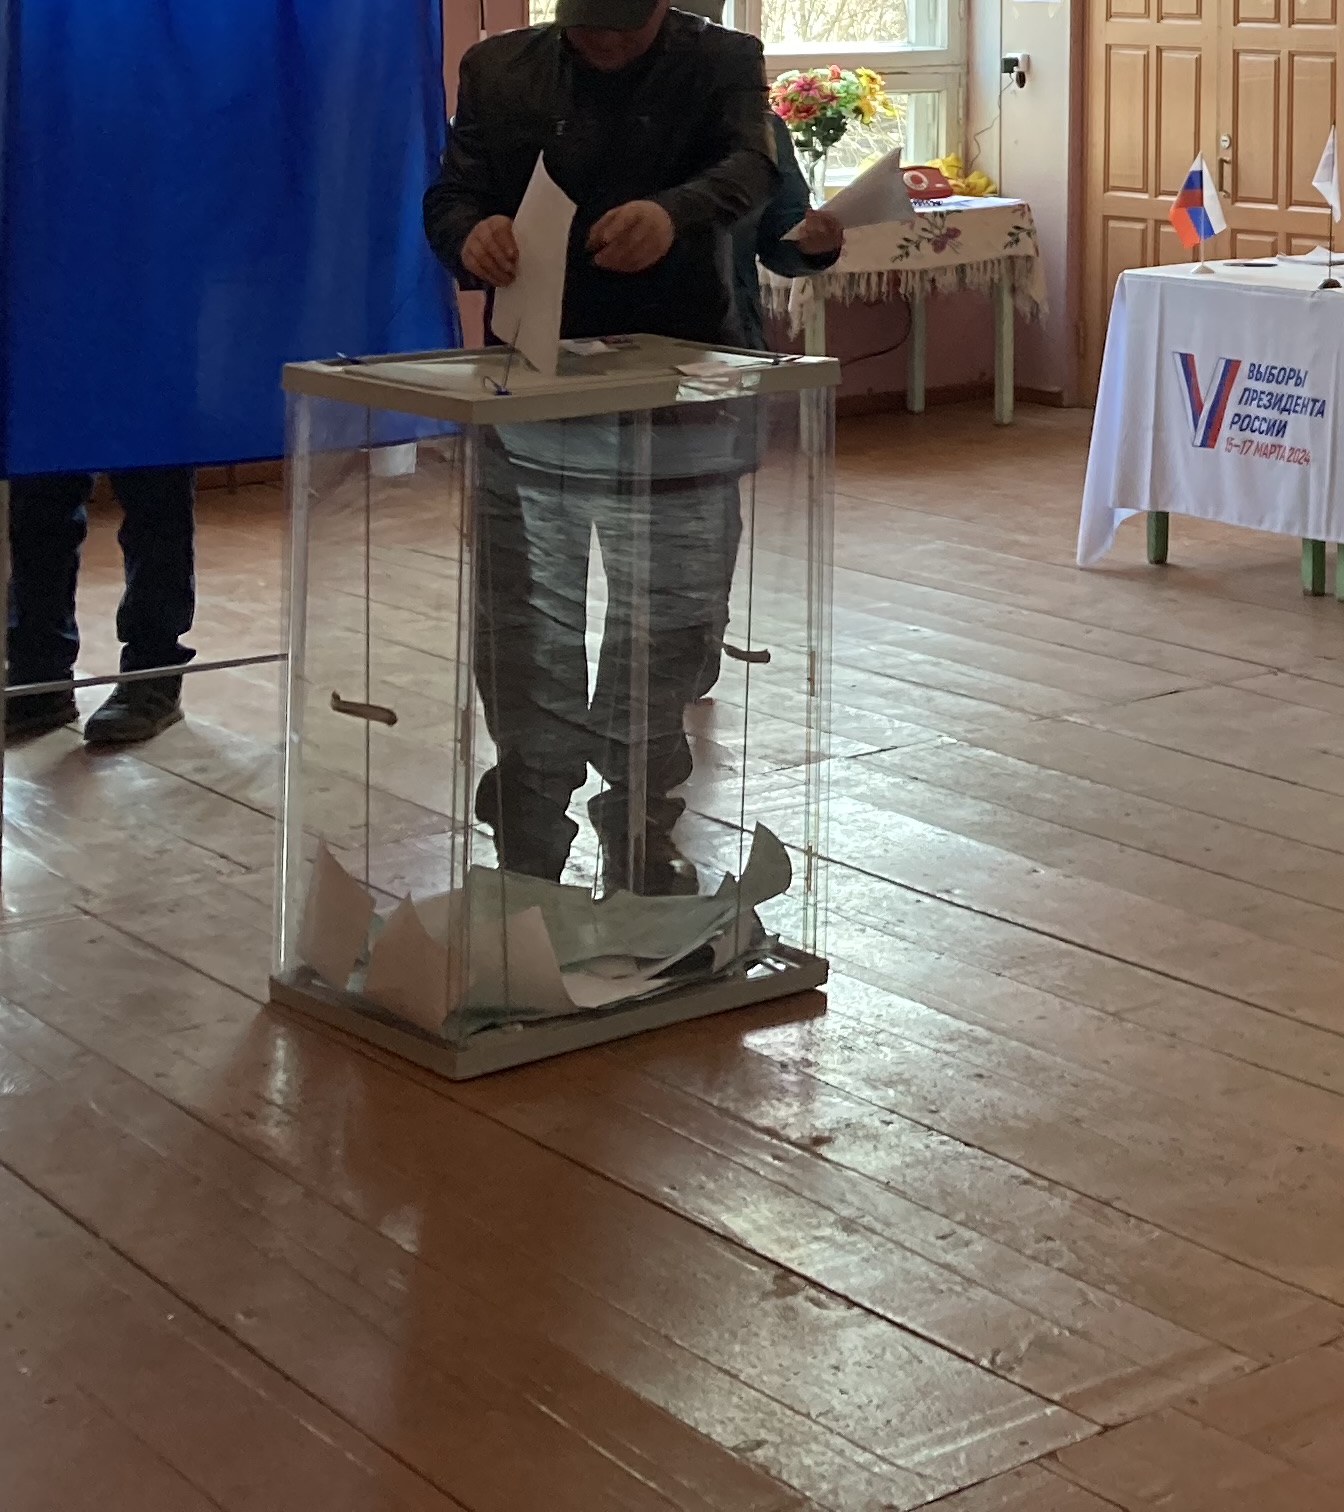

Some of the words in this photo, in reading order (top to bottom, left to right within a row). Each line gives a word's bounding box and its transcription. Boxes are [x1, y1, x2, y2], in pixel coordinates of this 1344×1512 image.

[1247, 362, 1309, 388] ВЫБОРЫ
[1237, 387, 1327, 419] ПРЕЗИДЕНТА
[1229, 413, 1288, 438] РОССИИ
[1253, 440, 1286, 462] МАРТА
[1286, 446, 1311, 466] 2024
